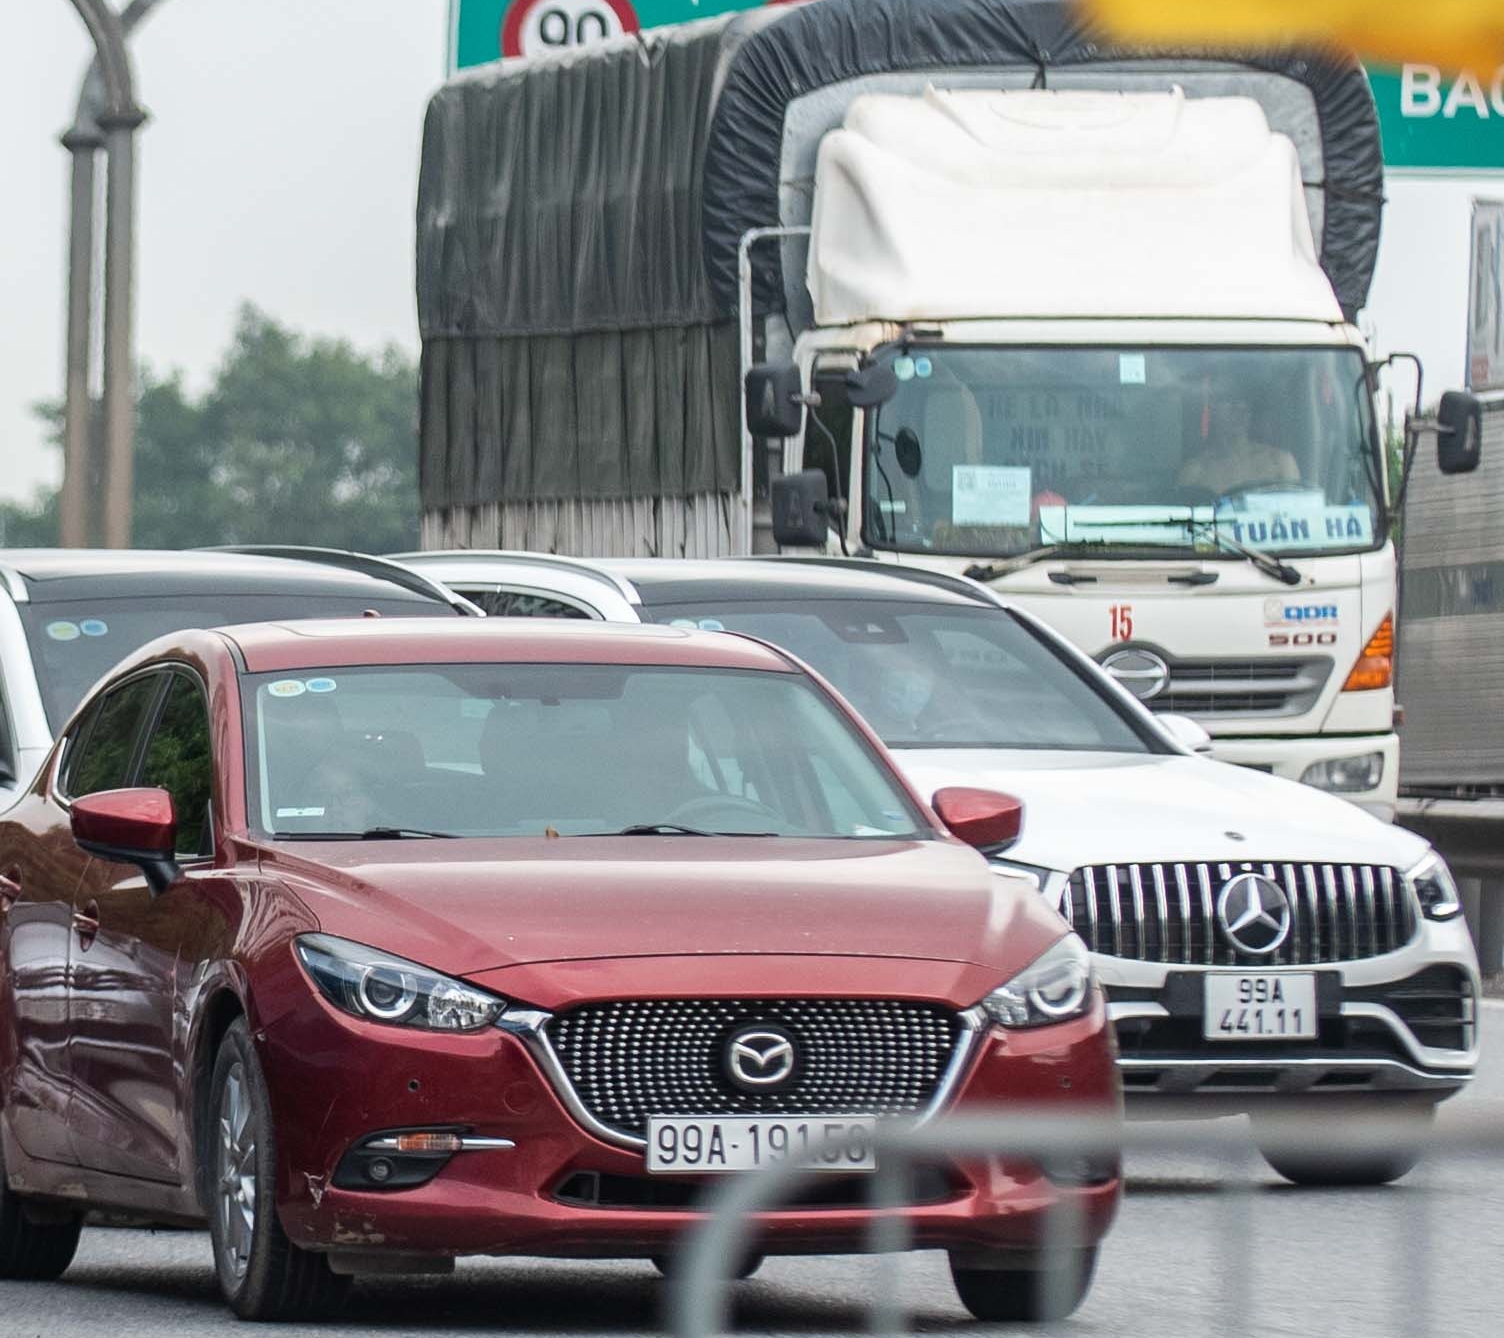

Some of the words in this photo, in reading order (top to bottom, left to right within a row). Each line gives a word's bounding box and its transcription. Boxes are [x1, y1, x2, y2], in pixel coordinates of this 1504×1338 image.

[1108, 604, 1133, 642] 15
[1268, 633, 1337, 647] 500
[1239, 978, 1286, 1004] 99A
[1219, 1008, 1302, 1035] 441.11
